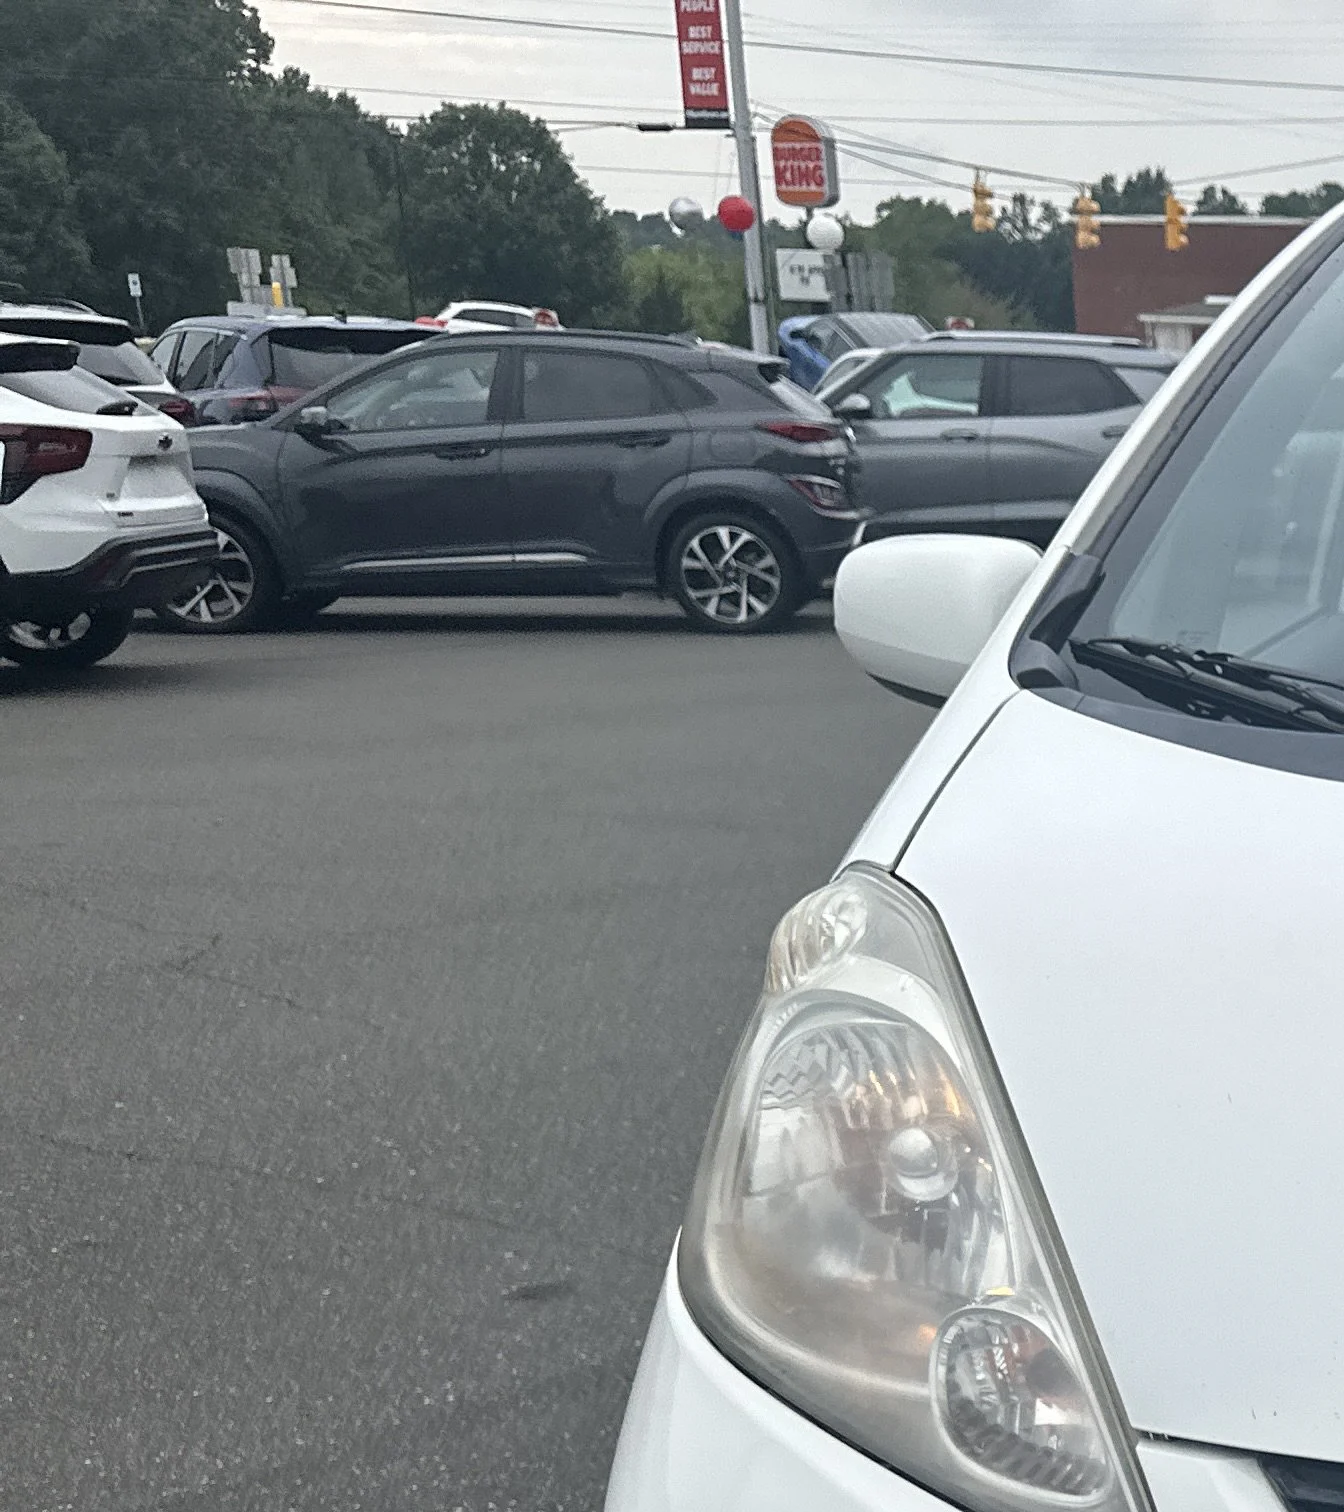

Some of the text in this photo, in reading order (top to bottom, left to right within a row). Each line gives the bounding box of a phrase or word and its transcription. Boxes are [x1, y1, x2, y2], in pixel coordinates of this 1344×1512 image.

[688, 25, 713, 39] BEST
[680, 40, 721, 55] SERVICE
[691, 67, 717, 81] BEST
[689, 81, 720, 96] VALUE
[773, 145, 822, 162] BURGER
[774, 164, 825, 187] KING
